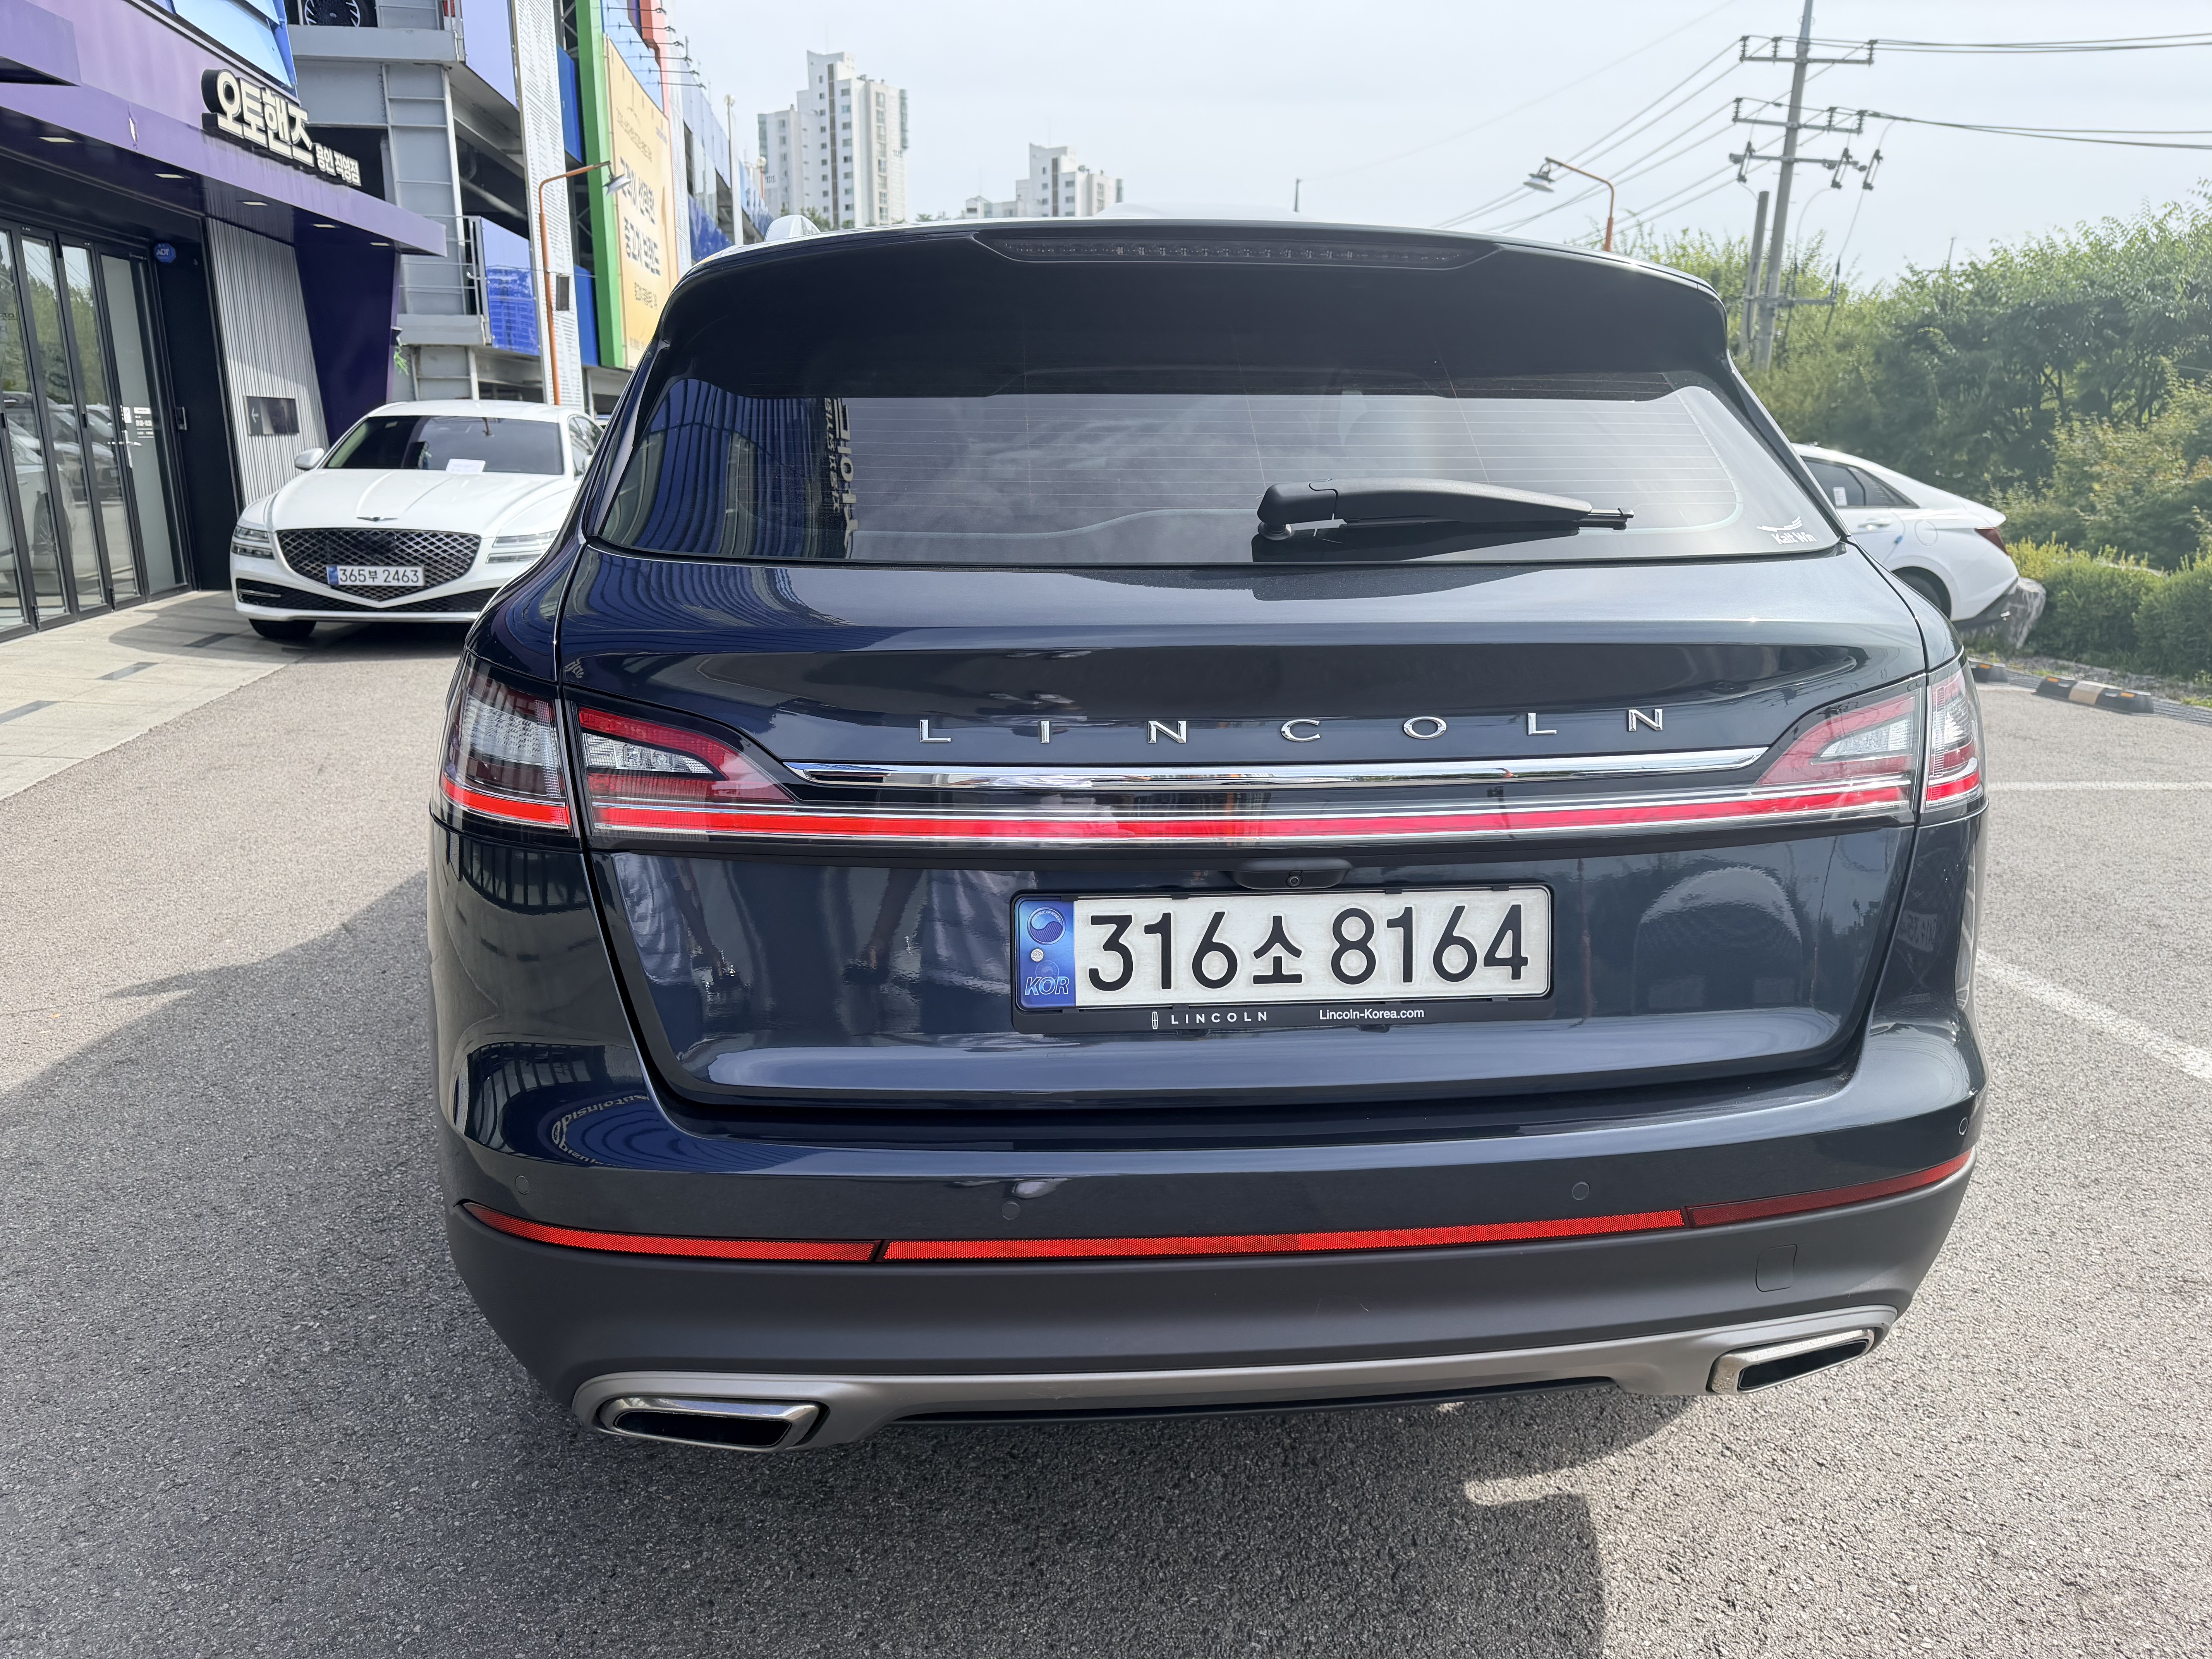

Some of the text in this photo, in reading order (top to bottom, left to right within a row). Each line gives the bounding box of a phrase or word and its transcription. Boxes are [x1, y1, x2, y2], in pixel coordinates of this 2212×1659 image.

[216, 70, 362, 186] 오토핸즈 용인 직영점
[624, 216, 661, 276] 중고차 브랜드
[339, 568, 419, 583] 365부 2463
[919, 708, 1663, 743] LINCOLN
[1088, 904, 1528, 992] 316소 8164
[1024, 976, 1070, 996] KOR
[1171, 1011, 1267, 1024] LINCOLN
[1319, 1008, 1425, 1020] Lincoln-Korea.com
